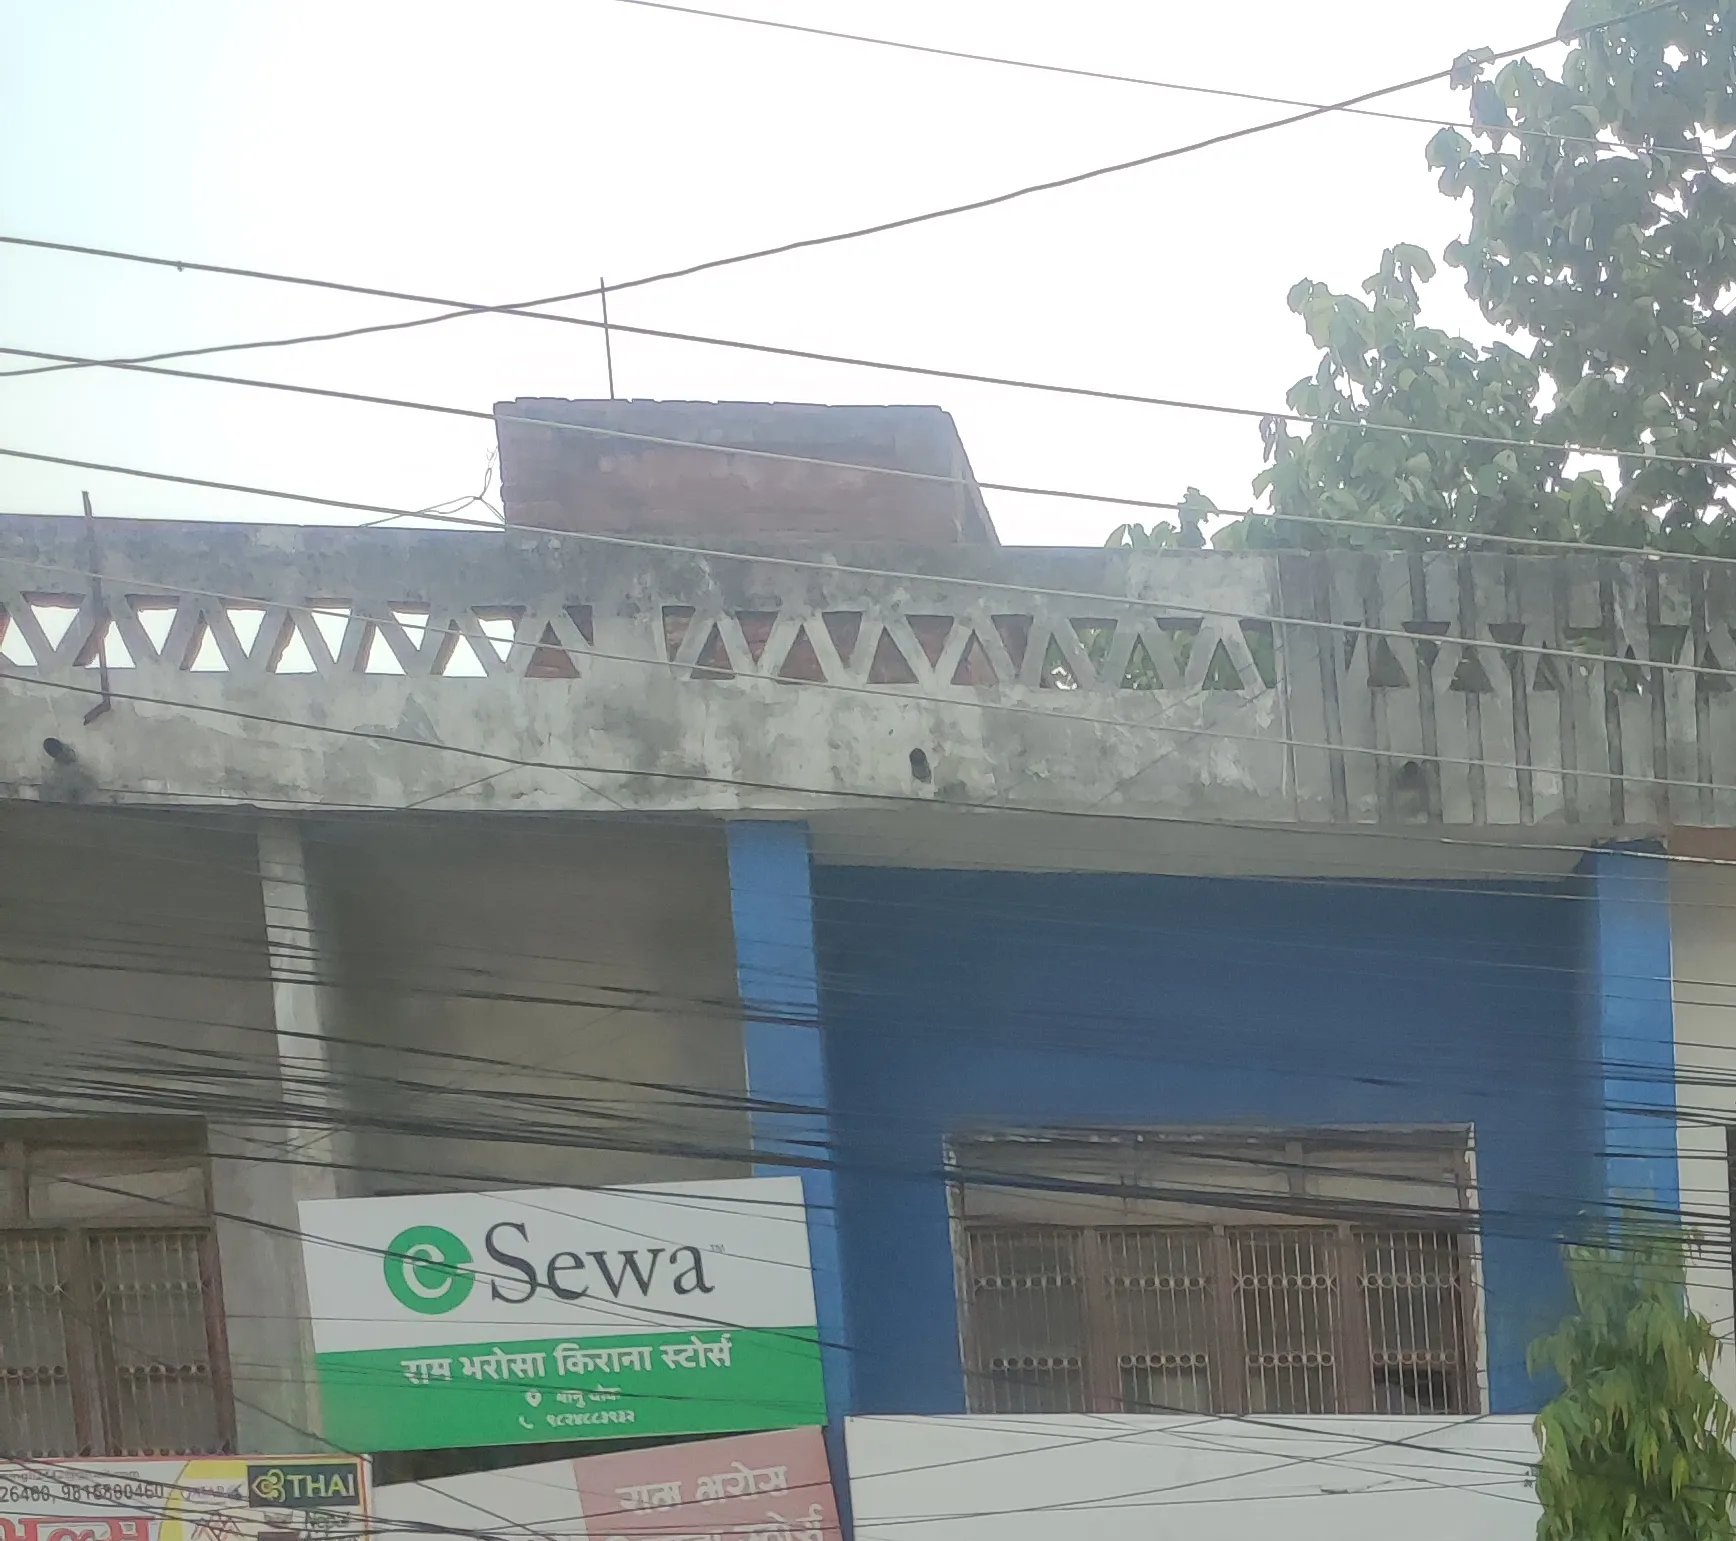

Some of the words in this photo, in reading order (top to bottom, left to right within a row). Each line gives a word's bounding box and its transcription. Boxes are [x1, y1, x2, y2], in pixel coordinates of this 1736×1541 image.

[400, 1358, 452, 1385] राम
[459, 1347, 546, 1380] भरोसा
[553, 1343, 653, 1375] किराना
[286, 1474, 355, 1498] THAI
